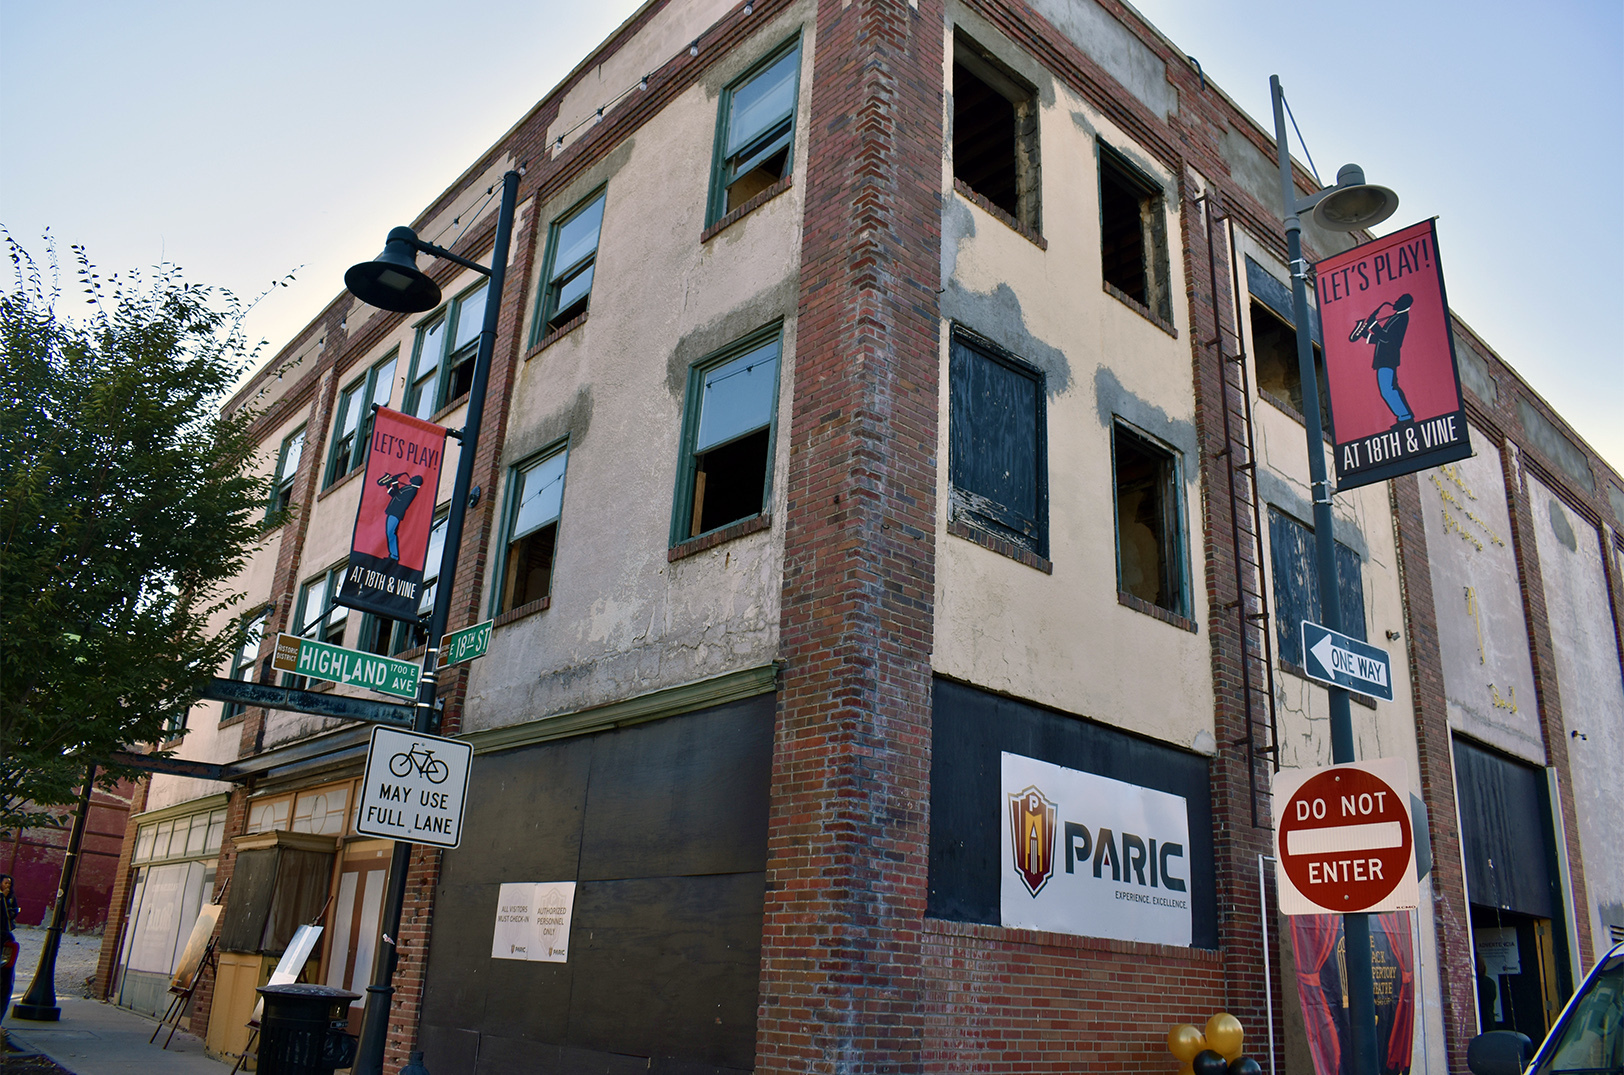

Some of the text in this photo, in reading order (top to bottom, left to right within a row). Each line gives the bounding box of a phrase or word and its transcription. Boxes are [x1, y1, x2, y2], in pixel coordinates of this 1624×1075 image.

[1321, 239, 1430, 305] LET'S PLAY!
[374, 431, 439, 471] LET'S PLAY!
[1343, 415, 1458, 471] AT 18TH & VINE
[350, 566, 417, 599] AT 18TH & VINE
[277, 644, 299, 654] HISTORIC
[450, 643, 455, 656] E
[455, 631, 476, 659] 18TH
[475, 627, 491, 652] ST
[276, 652, 297, 662] DISTRICT
[299, 645, 413, 693] HIGHLAND AVE
[390, 663, 415, 677] 1700 E
[1331, 650, 1382, 683] ONE WAY
[379, 783, 449, 810] MAY USE
[1296, 791, 1387, 821] DO NOT
[367, 806, 453, 835] FULL LANE
[1064, 821, 1187, 893] PARIC
[1308, 858, 1384, 884] ENTER
[501, 905, 528, 913] ALL VISITORS
[537, 907, 567, 915] AUTHORIZED
[1115, 890, 1188, 910] EXPERIENCE. EXCELLENCE.
[537, 917, 564, 925] PERSONNEL
[543, 928, 555, 936] ONLY
[1371, 951, 1386, 963] ACK
[1371, 966, 1397, 979] PERTORY
